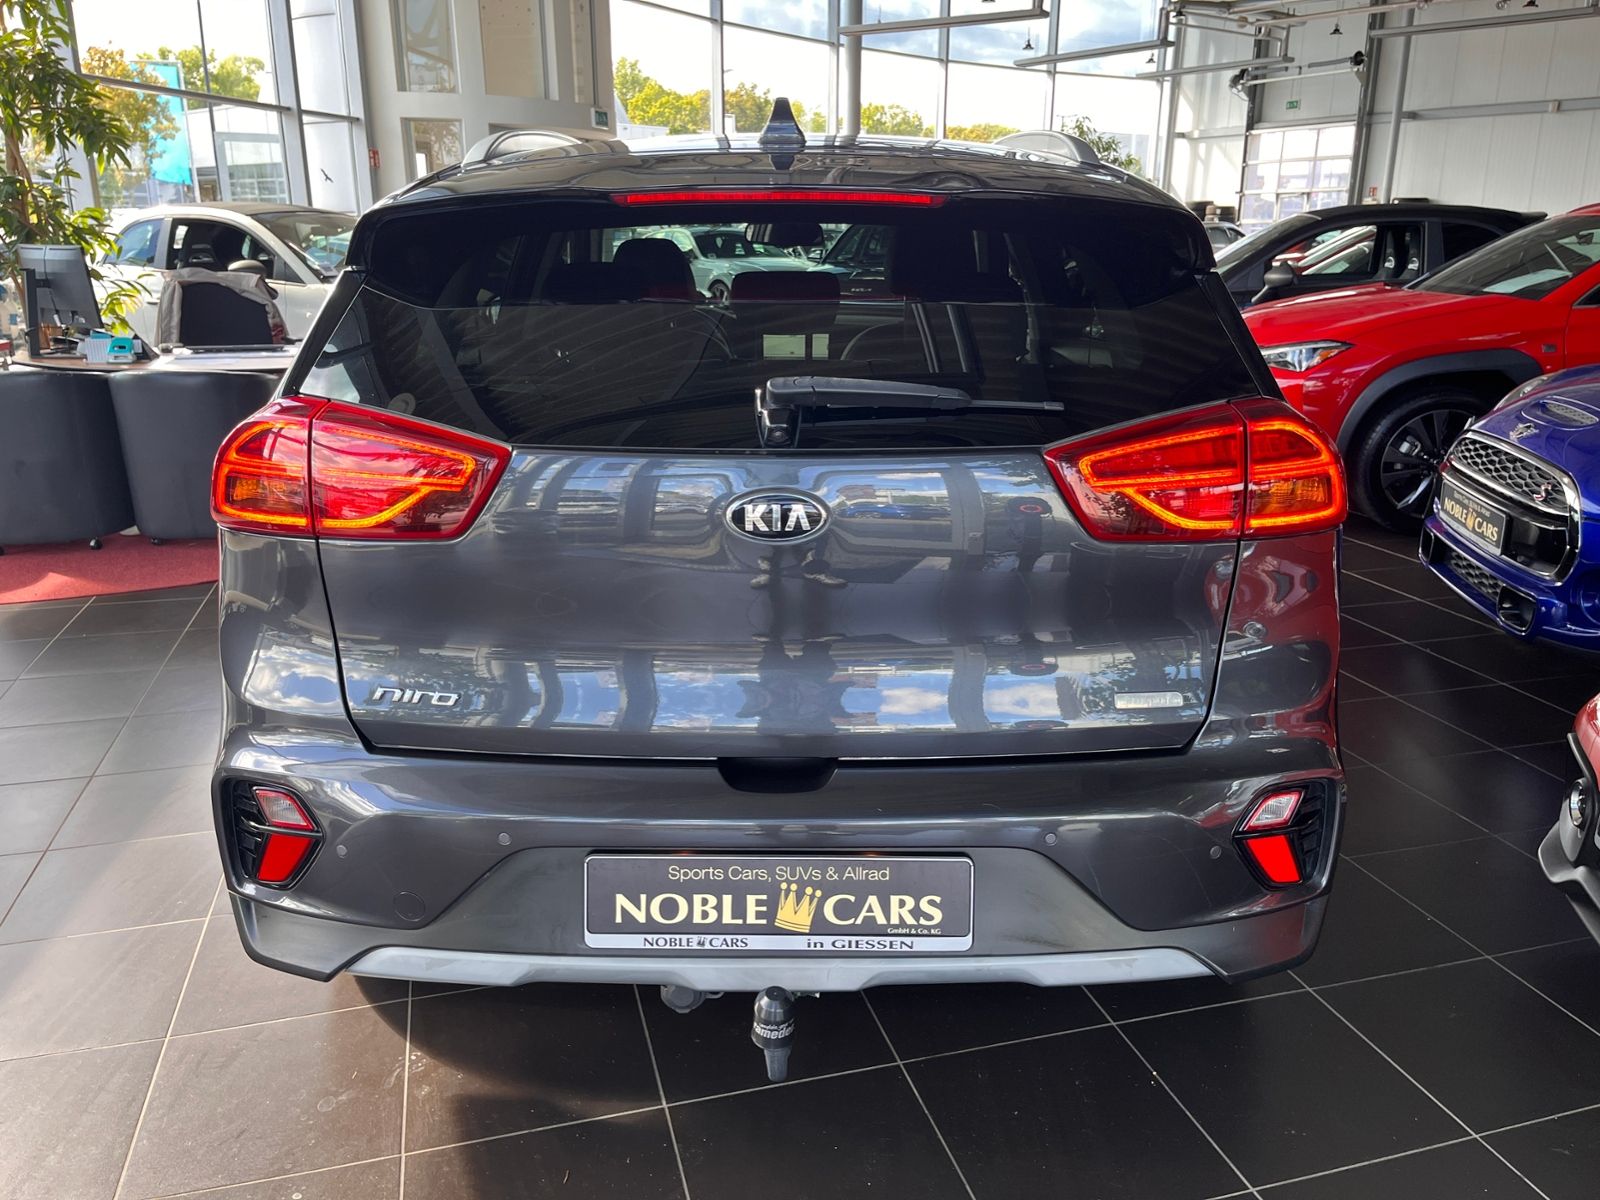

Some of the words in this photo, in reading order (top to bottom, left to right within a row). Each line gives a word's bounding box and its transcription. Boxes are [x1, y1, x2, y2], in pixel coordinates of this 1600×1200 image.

[743, 503, 811, 532] KIA
[1443, 496, 1468, 524] NOBLE
[1474, 517, 1499, 542] CARS
[372, 686, 460, 706] niro
[668, 865, 724, 882] Sports
[728, 865, 772, 882] Cars,
[775, 866, 821, 881] SUVs
[825, 866, 839, 881] &
[843, 866, 890, 881] Allrad
[615, 893, 768, 925] NOBLE
[823, 894, 943, 926] CARS
[887, 927, 909, 935] GmbH
[911, 927, 917, 935] &
[918, 927, 930, 935] Co.
[643, 937, 694, 948] NOBLE
[708, 937, 749, 948] CARS
[807, 938, 824, 949] in
[831, 939, 914, 950] GIESSEN
